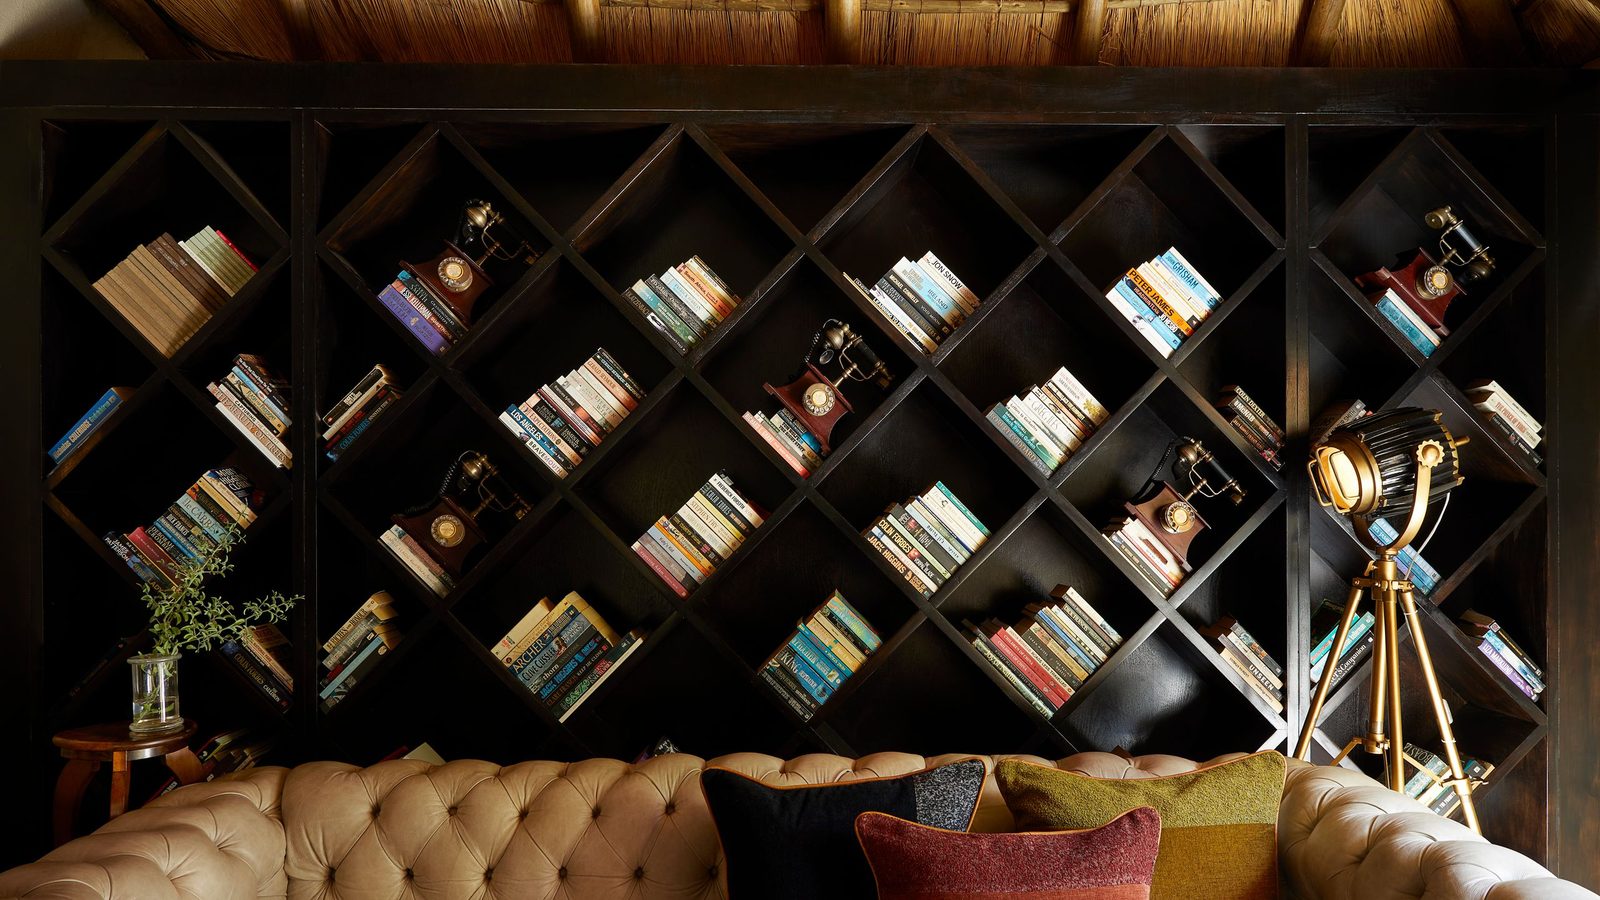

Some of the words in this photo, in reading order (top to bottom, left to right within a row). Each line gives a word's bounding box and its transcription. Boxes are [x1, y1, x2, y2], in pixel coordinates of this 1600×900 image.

[683, 271, 696, 284] South
[694, 281, 708, 295] Africa,
[881, 279, 891, 289] THE
[932, 259, 946, 274] JON
[943, 271, 963, 291] SNOW
[1171, 262, 1200, 289] GRISHAM
[408, 285, 428, 304] SMITH
[881, 286, 898, 303] FEATHER
[889, 274, 905, 290] MICHAEL
[902, 288, 920, 305] CONNELLY
[927, 289, 949, 311] IRELAND
[1128, 270, 1154, 294] PETER
[1149, 292, 1176, 317] JAMES
[384, 297, 408, 320] SMITH
[390, 292, 413, 314] WILBUR
[873, 298, 893, 318] LEARNING
[901, 303, 920, 322] MINETTE
[917, 320, 937, 339] WALTERS
[928, 313, 942, 327] MOON
[1158, 313, 1167, 321] JO
[586, 360, 603, 376] GERALD
[600, 373, 618, 390] SEYMOUR
[233, 400, 257, 423] CAPTURING
[540, 404, 551, 415] DEN
[548, 412, 557, 421] OF
[1010, 403, 1022, 415] Letters
[1030, 399, 1051, 420] GREG
[1235, 387, 1251, 403] COLIN
[1248, 400, 1266, 418] DEXTER
[1236, 403, 1256, 423] McNAB
[1495, 402, 1505, 412] THE
[1511, 417, 1519, 425] OF
[213, 390, 230, 406] THE
[228, 404, 256, 430] BEAUTY
[255, 430, 267, 442] OF
[264, 440, 288, 463] TREES
[510, 409, 524, 422] LOS
[519, 419, 543, 442] ANGELES
[528, 413, 559, 443] EXPECTATIONS
[533, 406, 553, 425] THIEVES
[1343, 409, 1357, 422] SMITH
[338, 432, 357, 451] COLIN
[352, 418, 372, 437] FORBES
[559, 431, 580, 451] STEWART
[564, 428, 576, 440] JAMES
[779, 425, 787, 434] THE
[785, 432, 797, 443] RIGHT
[794, 441, 806, 453] STUFF
[782, 422, 791, 431] TOM
[789, 429, 801, 441] WOLFE
[987, 413, 1012, 436] ROBERT
[1008, 434, 1038, 463] GODDARD
[1001, 414, 1015, 427] Black
[1012, 425, 1025, 438] Swan
[1022, 435, 1038, 450] Green
[527, 440, 564, 474] BRAVEMOUTH
[184, 499, 195, 509] le
[716, 481, 734, 498] FREDERICK
[731, 495, 746, 510] FORSYTH
[166, 513, 178, 526] DICK
[174, 521, 190, 537] FRANCIS
[690, 500, 711, 521] STEPHEN
[707, 518, 719, 530] FRY
[103, 536, 130, 563] PATTERSON
[112, 538, 130, 555] JAMES
[147, 529, 172, 553] CROMBIE
[151, 525, 175, 549] DEBORAH
[878, 519, 895, 537] COLIN
[891, 533, 913, 555] FORBES
[638, 551, 655, 567] expecting
[654, 564, 666, 576] Adam
[867, 535, 886, 553] JACK
[881, 549, 908, 575] HIGGINS
[147, 578, 164, 595] LADY
[908, 579, 924, 594] DANGER
[911, 576, 922, 586] EDGE
[924, 568, 936, 580] BLADE
[329, 627, 349, 646] RICHES
[349, 608, 368, 627] HONOUR
[1063, 606, 1075, 618] DICK
[1072, 615, 1089, 631] FRANCIS
[563, 637, 571, 645] OF
[568, 625, 583, 639] KHAN
[509, 637, 548, 673] ARCHER
[520, 663, 540, 682] CLIVE
[532, 644, 560, 670] CUSSLER
[576, 665, 587, 676] KEEP
[591, 649, 605, 662] CLOSE
[997, 640, 1015, 658] CHILDREN
[1017, 660, 1029, 672] CHINA
[1002, 635, 1021, 652] CHILDREN
[1022, 654, 1034, 666] CHINA
[1338, 642, 1369, 673] Companion
[1482, 644, 1494, 656] LIZA
[1489, 652, 1514, 676] MARKLUND
[233, 652, 252, 671] COLIN
[246, 665, 267, 685] FORBES
[541, 662, 561, 681] thorn
[781, 653, 803, 674] KING
[1030, 651, 1044, 664] ROADS
[1041, 662, 1052, 672] LESS
[1049, 670, 1068, 688] TRAVELLED
[538, 680, 558, 699] JACK
[553, 658, 581, 684] HIGGINS
[544, 690, 561, 707] CLARE
[557, 673, 581, 694] FRANCIS
[1248, 664, 1276, 691] UNSEEN
